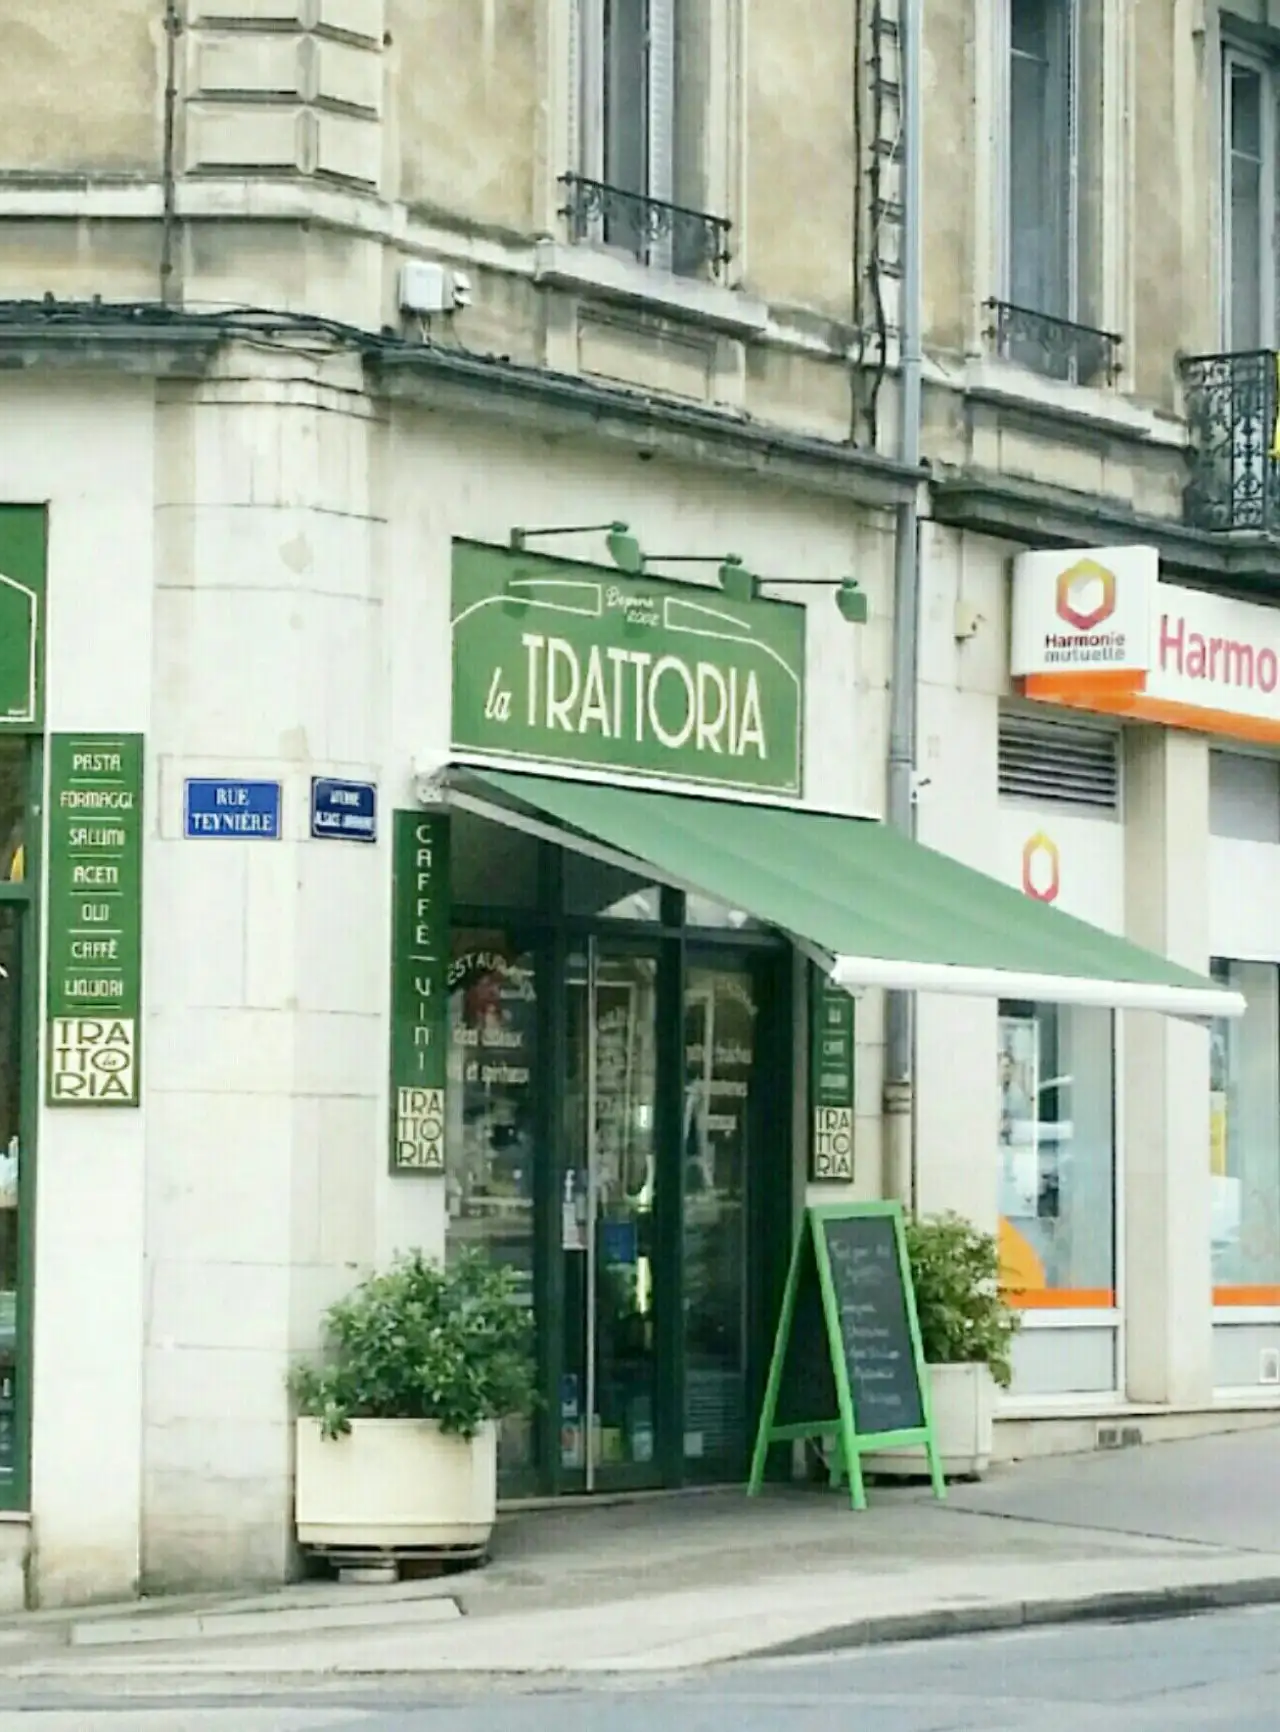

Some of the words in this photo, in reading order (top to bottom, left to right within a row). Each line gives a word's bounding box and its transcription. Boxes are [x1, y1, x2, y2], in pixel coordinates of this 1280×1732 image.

[1044, 632, 1126, 649] Harmonie
[1044, 647, 1126, 663] mutuelle
[1159, 614, 1279, 694] Harmo
[484, 667, 512, 722] la
[522, 633, 767, 760] TRATTORIA
[73, 754, 121, 771] PASTA
[60, 790, 133, 809] FORMAGGI
[216, 787, 250, 806] RUE
[69, 828, 125, 846] SALUMI
[73, 866, 119, 884] ACETI
[65, 979, 123, 996] LIQUORI
